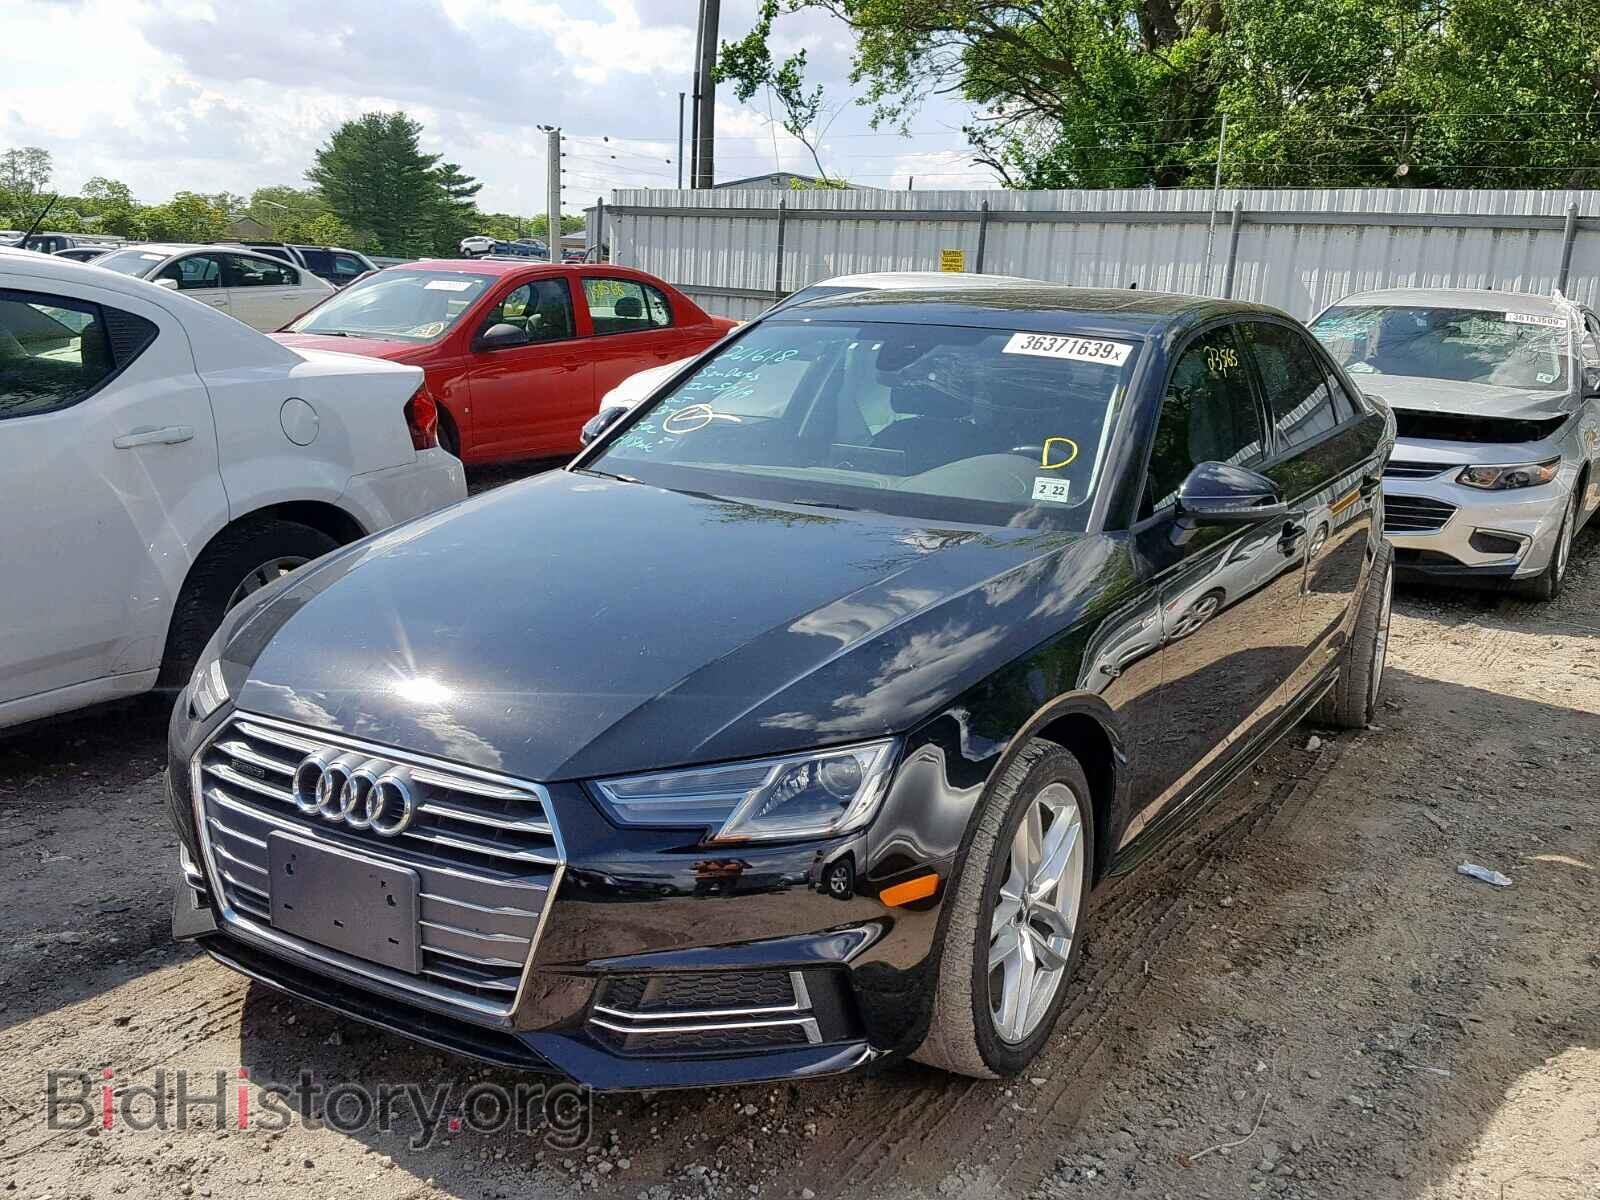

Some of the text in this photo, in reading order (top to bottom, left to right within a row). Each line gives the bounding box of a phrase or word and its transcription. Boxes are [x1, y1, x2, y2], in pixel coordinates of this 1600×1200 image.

[1020, 334, 1123, 361] 36371639x
[1039, 437, 1078, 469] D
[1039, 484, 1065, 496] 2 22
